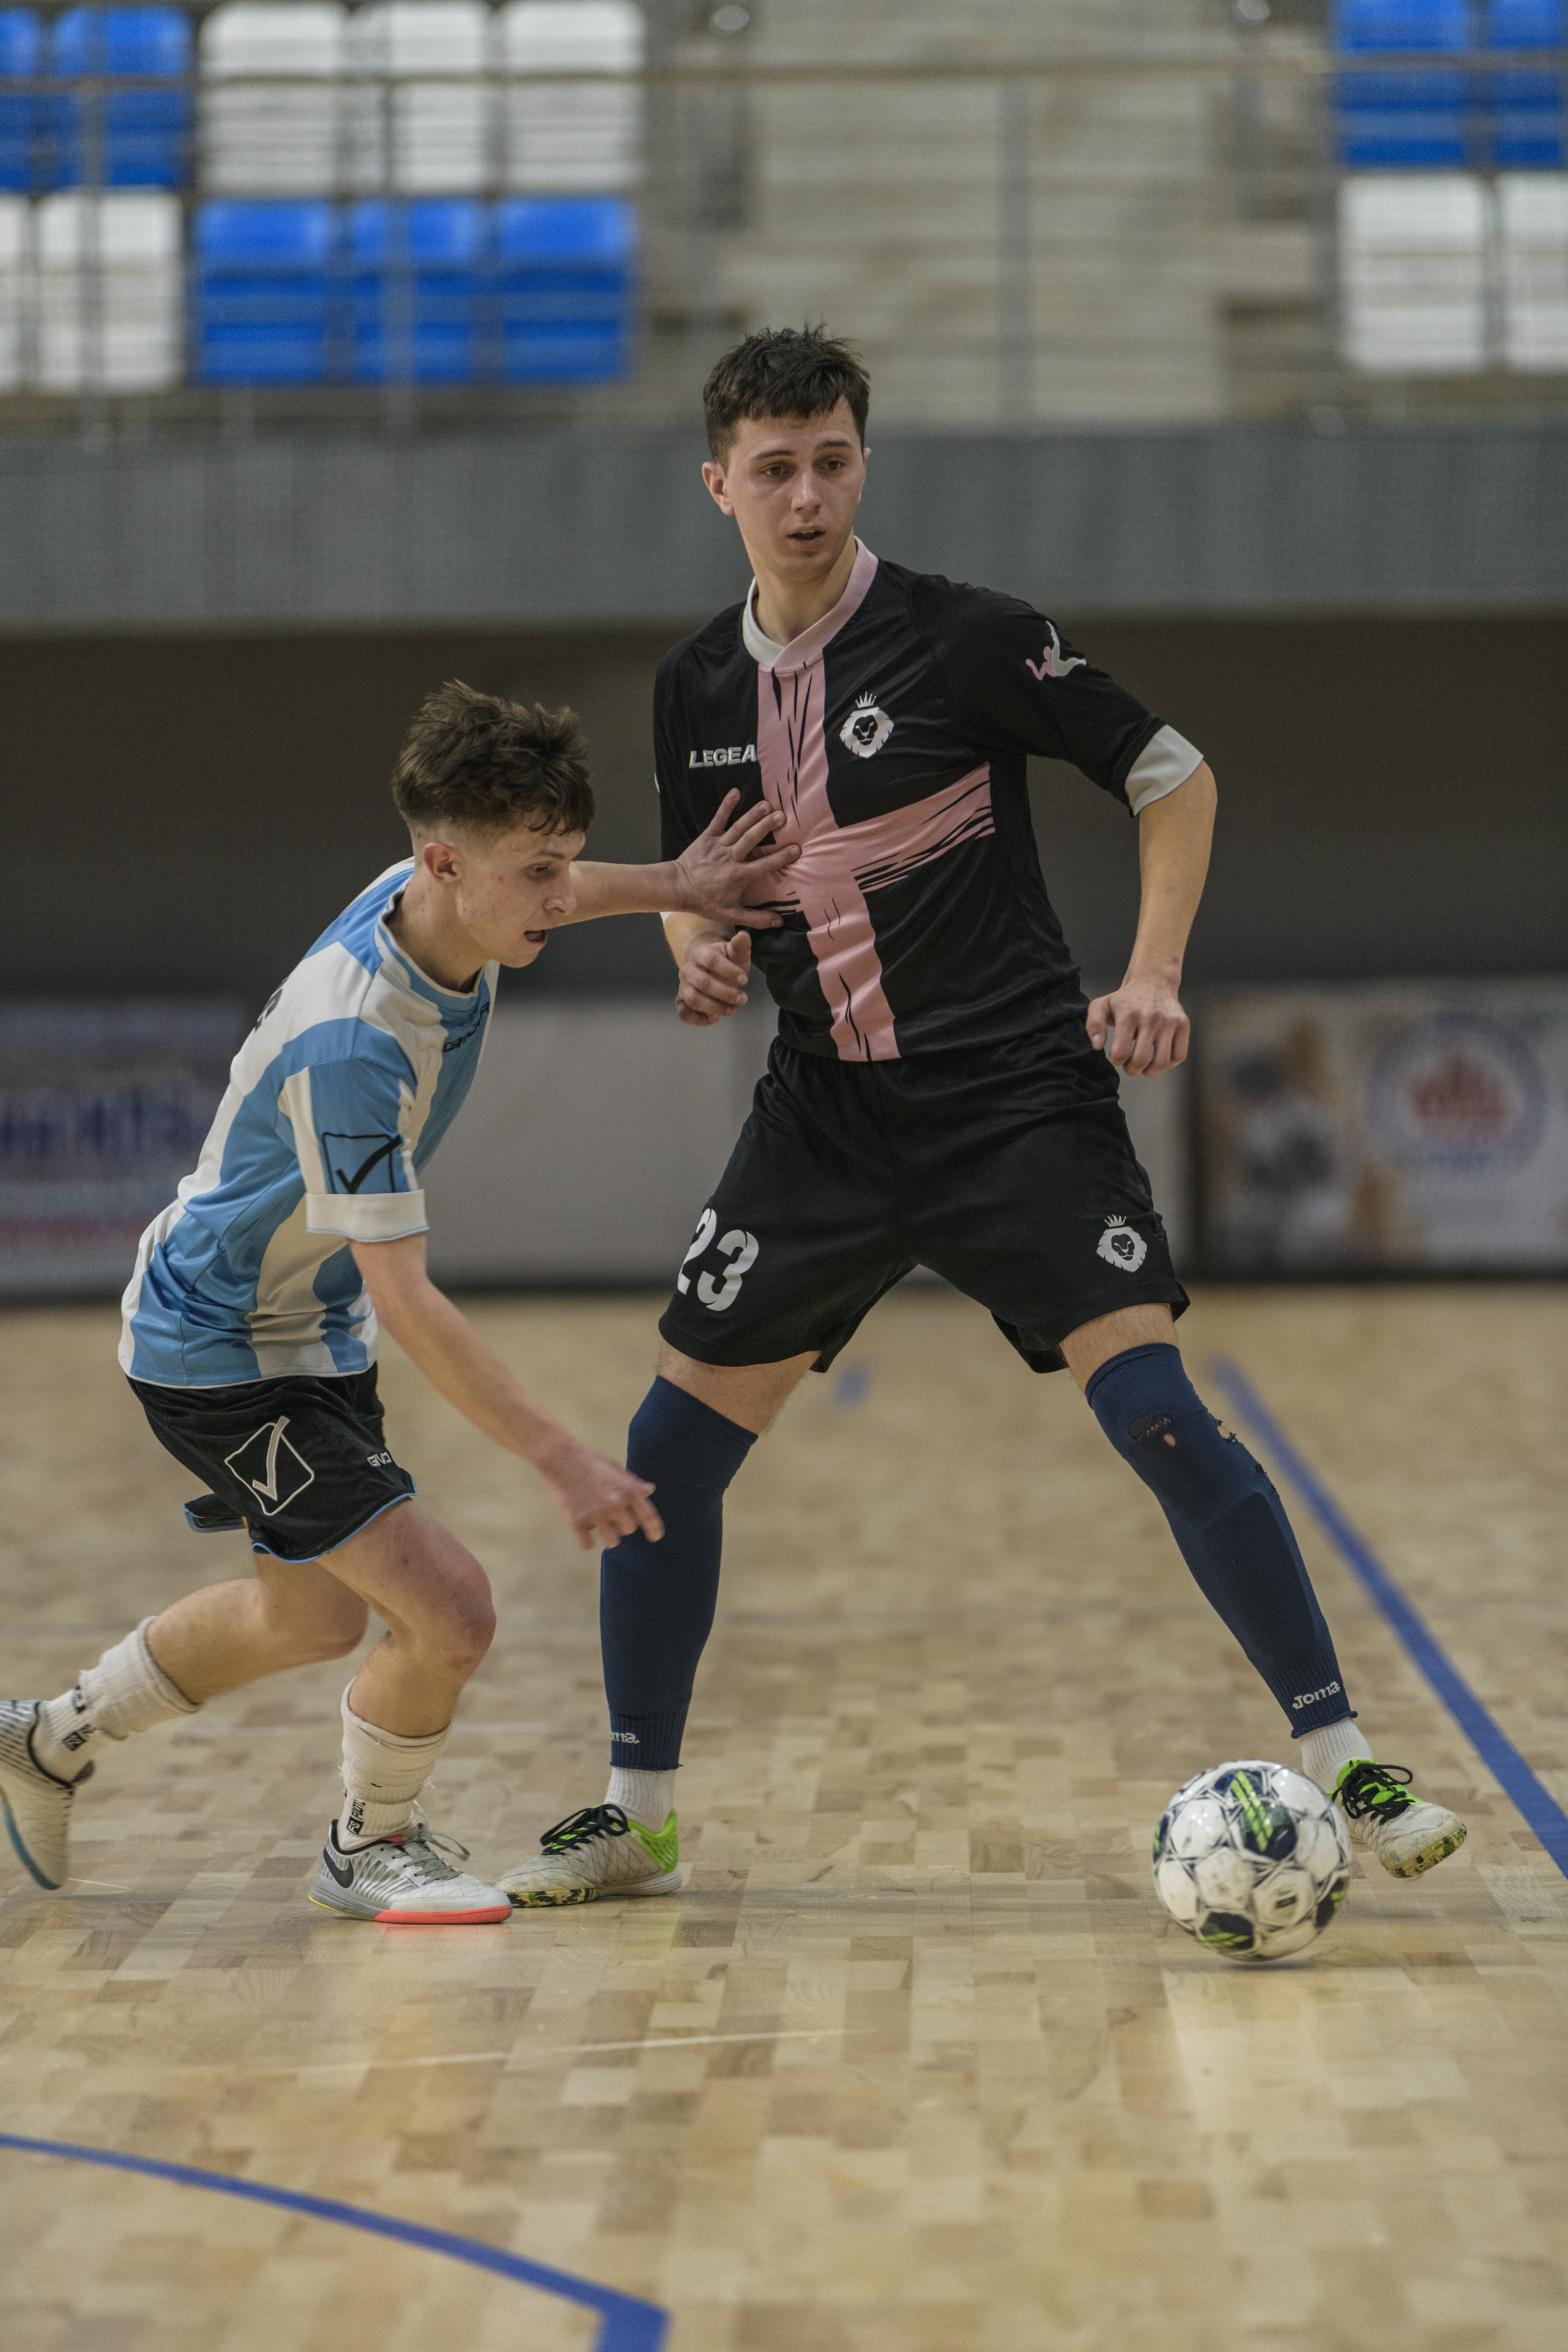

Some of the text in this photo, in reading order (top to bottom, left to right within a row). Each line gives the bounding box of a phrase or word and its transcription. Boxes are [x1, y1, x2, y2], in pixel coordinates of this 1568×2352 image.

[688, 744, 757, 769] LEGEA
[677, 1208, 760, 1312] 23
[610, 1732, 641, 1744] ma
